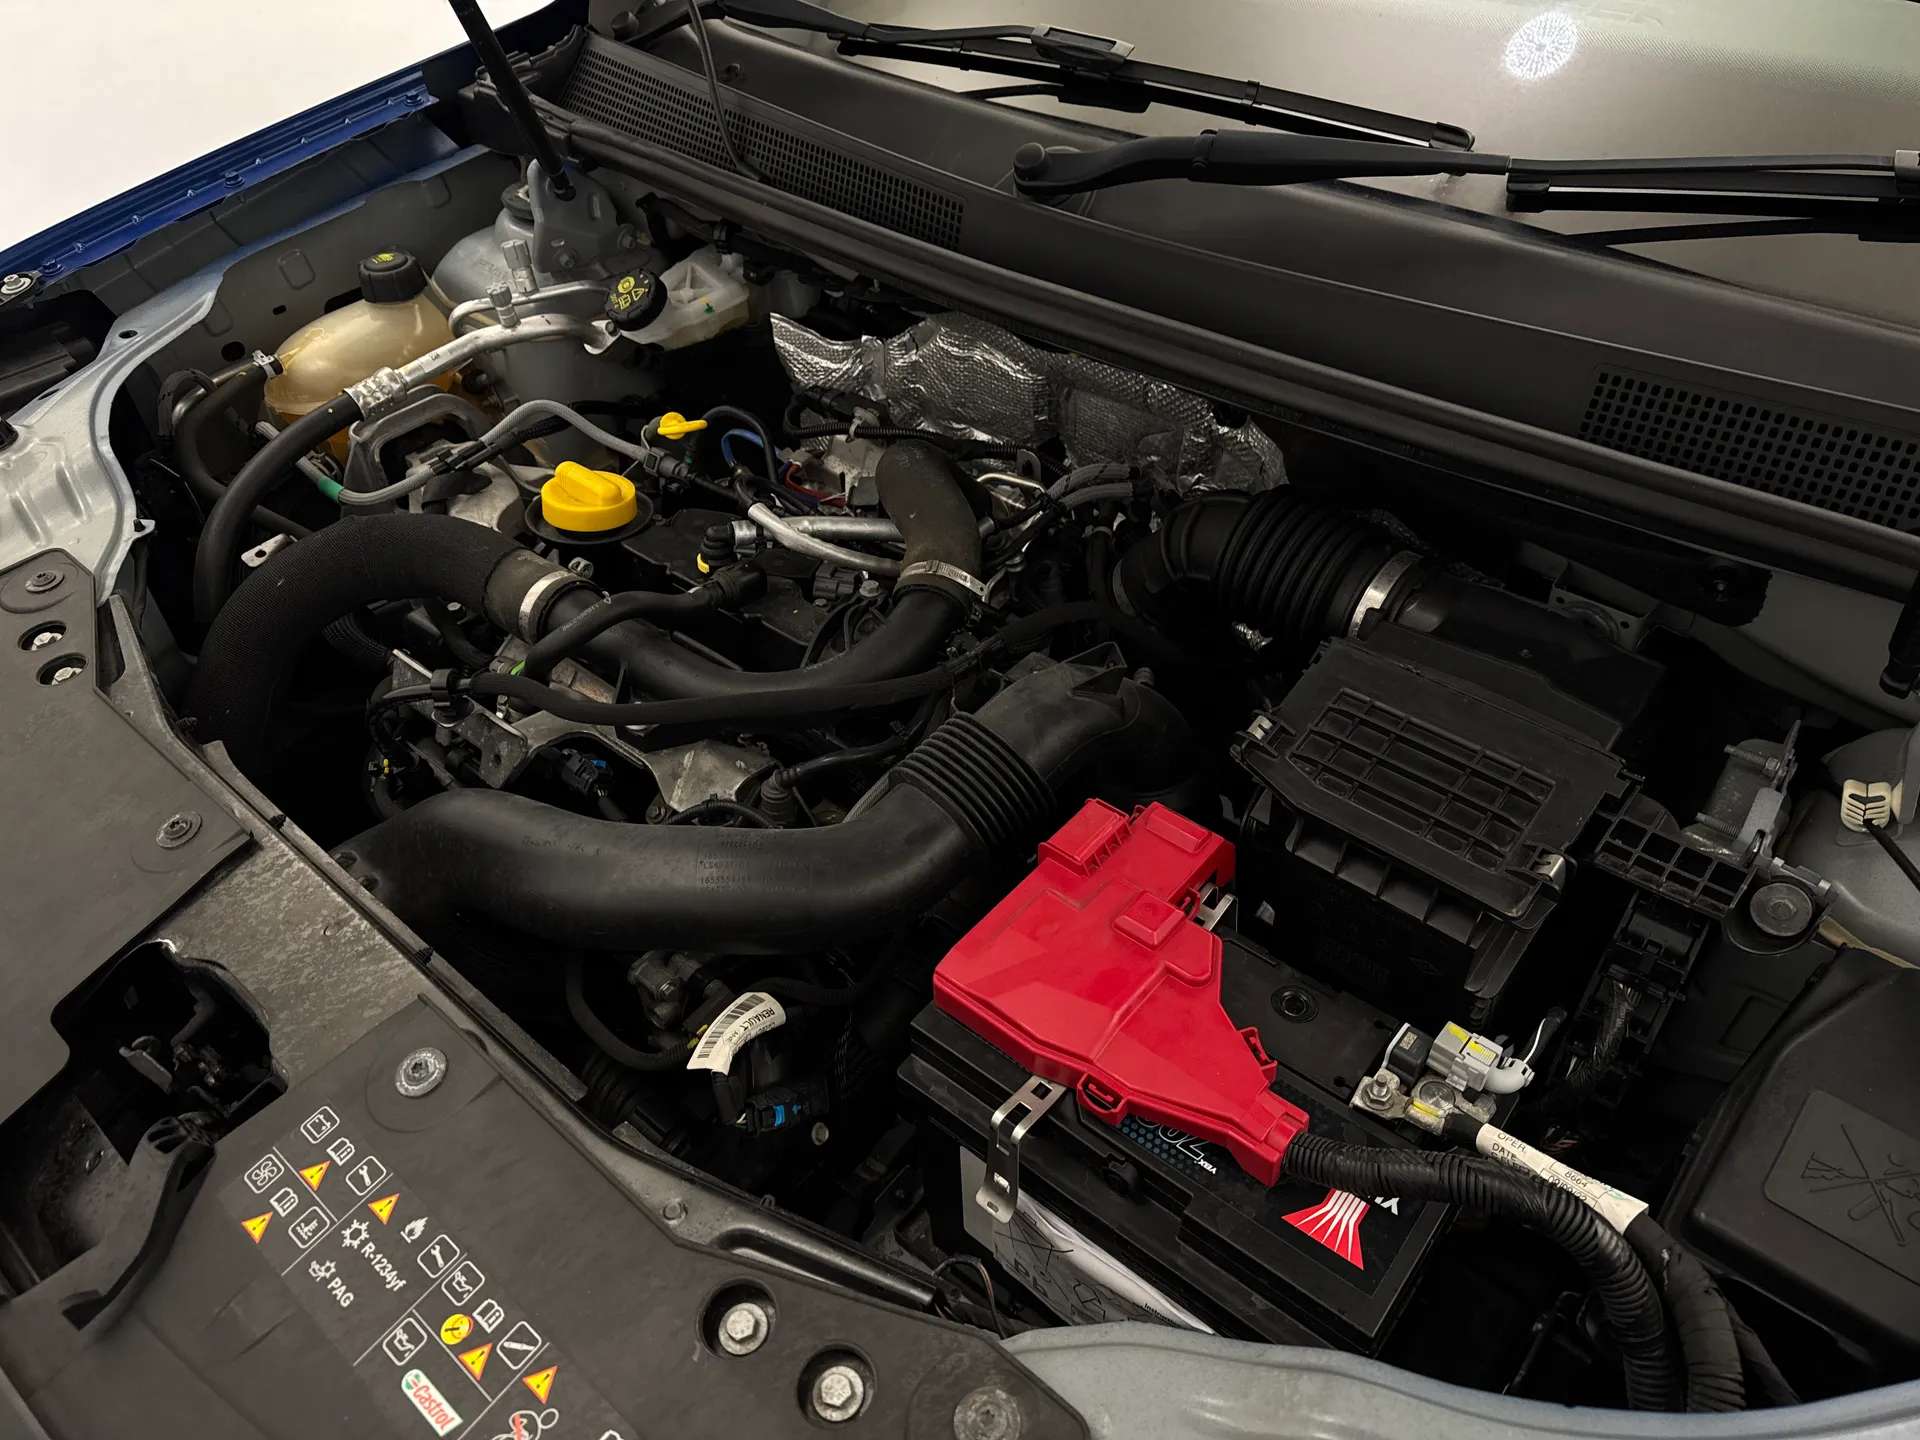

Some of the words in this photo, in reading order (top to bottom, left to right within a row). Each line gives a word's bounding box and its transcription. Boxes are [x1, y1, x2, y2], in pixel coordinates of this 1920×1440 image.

[743, 1007, 775, 1031] RENAULT
[361, 1242, 407, 1292] R-1234yf
[327, 1277, 354, 1308] PAG
[412, 1385, 456, 1433] Castrol
